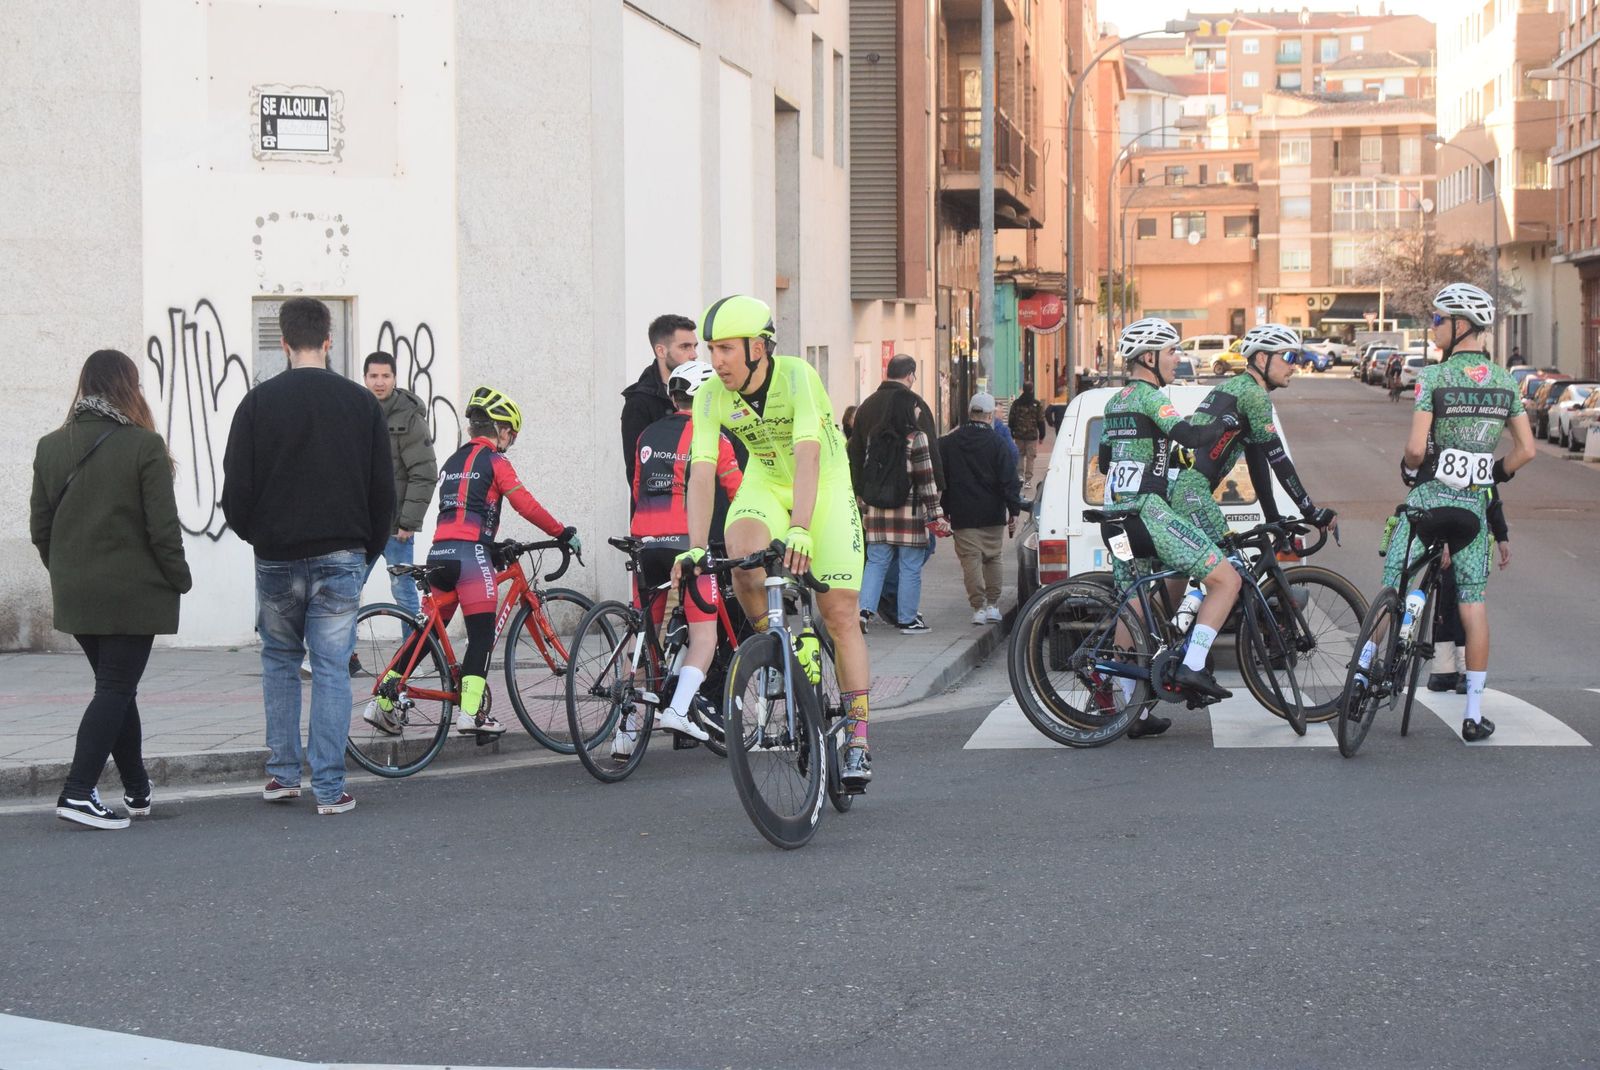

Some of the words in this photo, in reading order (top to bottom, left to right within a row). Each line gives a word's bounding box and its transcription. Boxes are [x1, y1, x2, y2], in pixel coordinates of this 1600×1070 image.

[262, 97, 277, 115] SE
[279, 98, 327, 117] ALQUILA
[1443, 392, 1511, 408] SAKATA
[653, 451, 692, 461] MORALEJ
[1443, 453, 1468, 478] 83
[446, 472, 480, 480] MORALEJO
[1117, 466, 1139, 488] 87
[735, 508, 767, 518] ZICO
[475, 544, 487, 565] CAJA
[480, 566, 495, 599] RURAL
[710, 573, 718, 602] URAL
